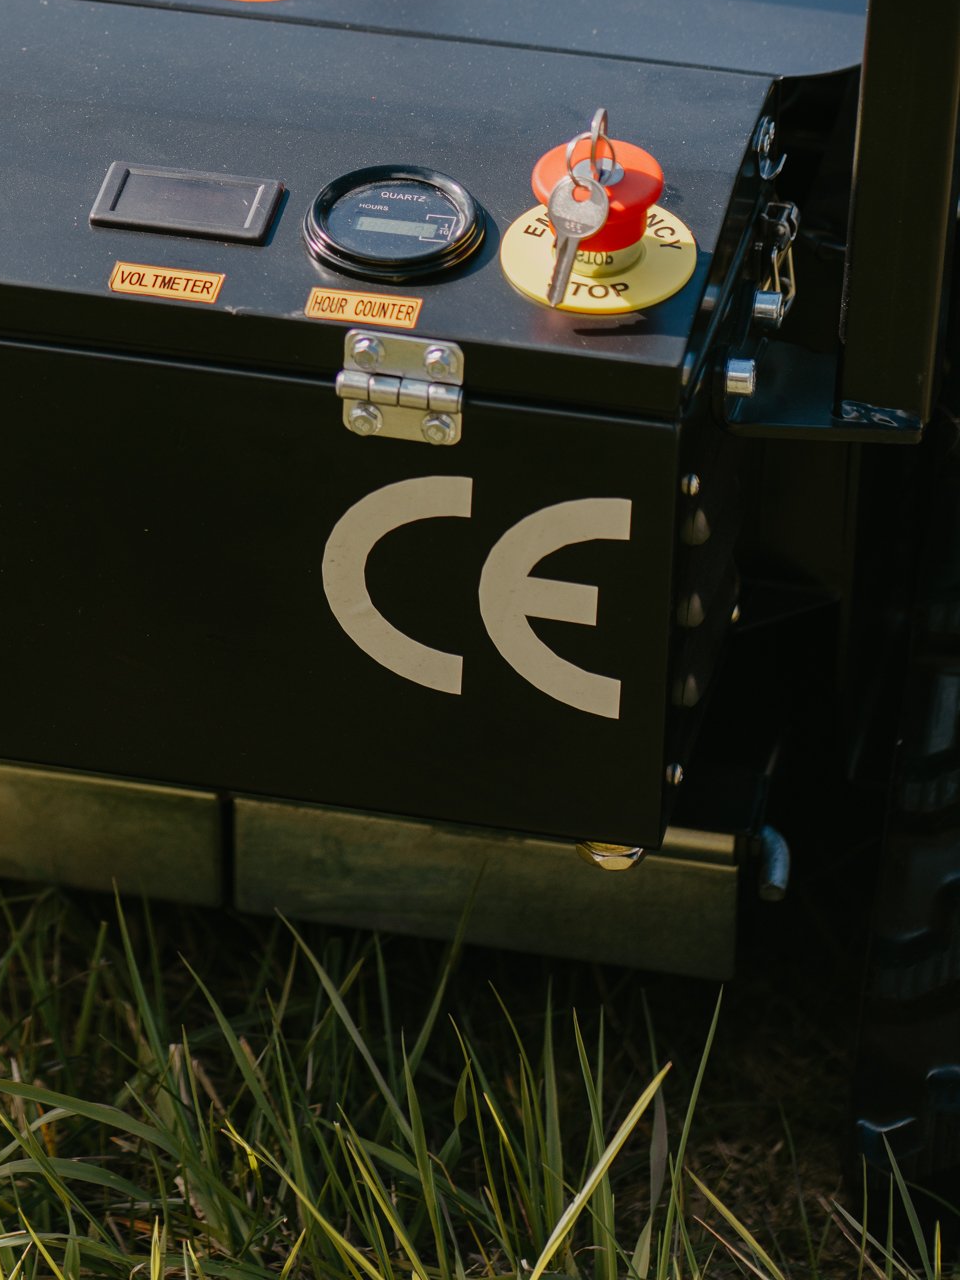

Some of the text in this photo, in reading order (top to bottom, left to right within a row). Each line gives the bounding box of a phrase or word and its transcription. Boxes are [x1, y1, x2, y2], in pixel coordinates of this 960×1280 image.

[358, 203, 389, 211] HOURS
[380, 191, 427, 202] QUARTZ
[120, 271, 214, 295] VOLTMETER
[548, 281, 630, 299] TOP
[312, 294, 415, 322] HOUR COUNTER
[321, 475, 632, 719] CE
